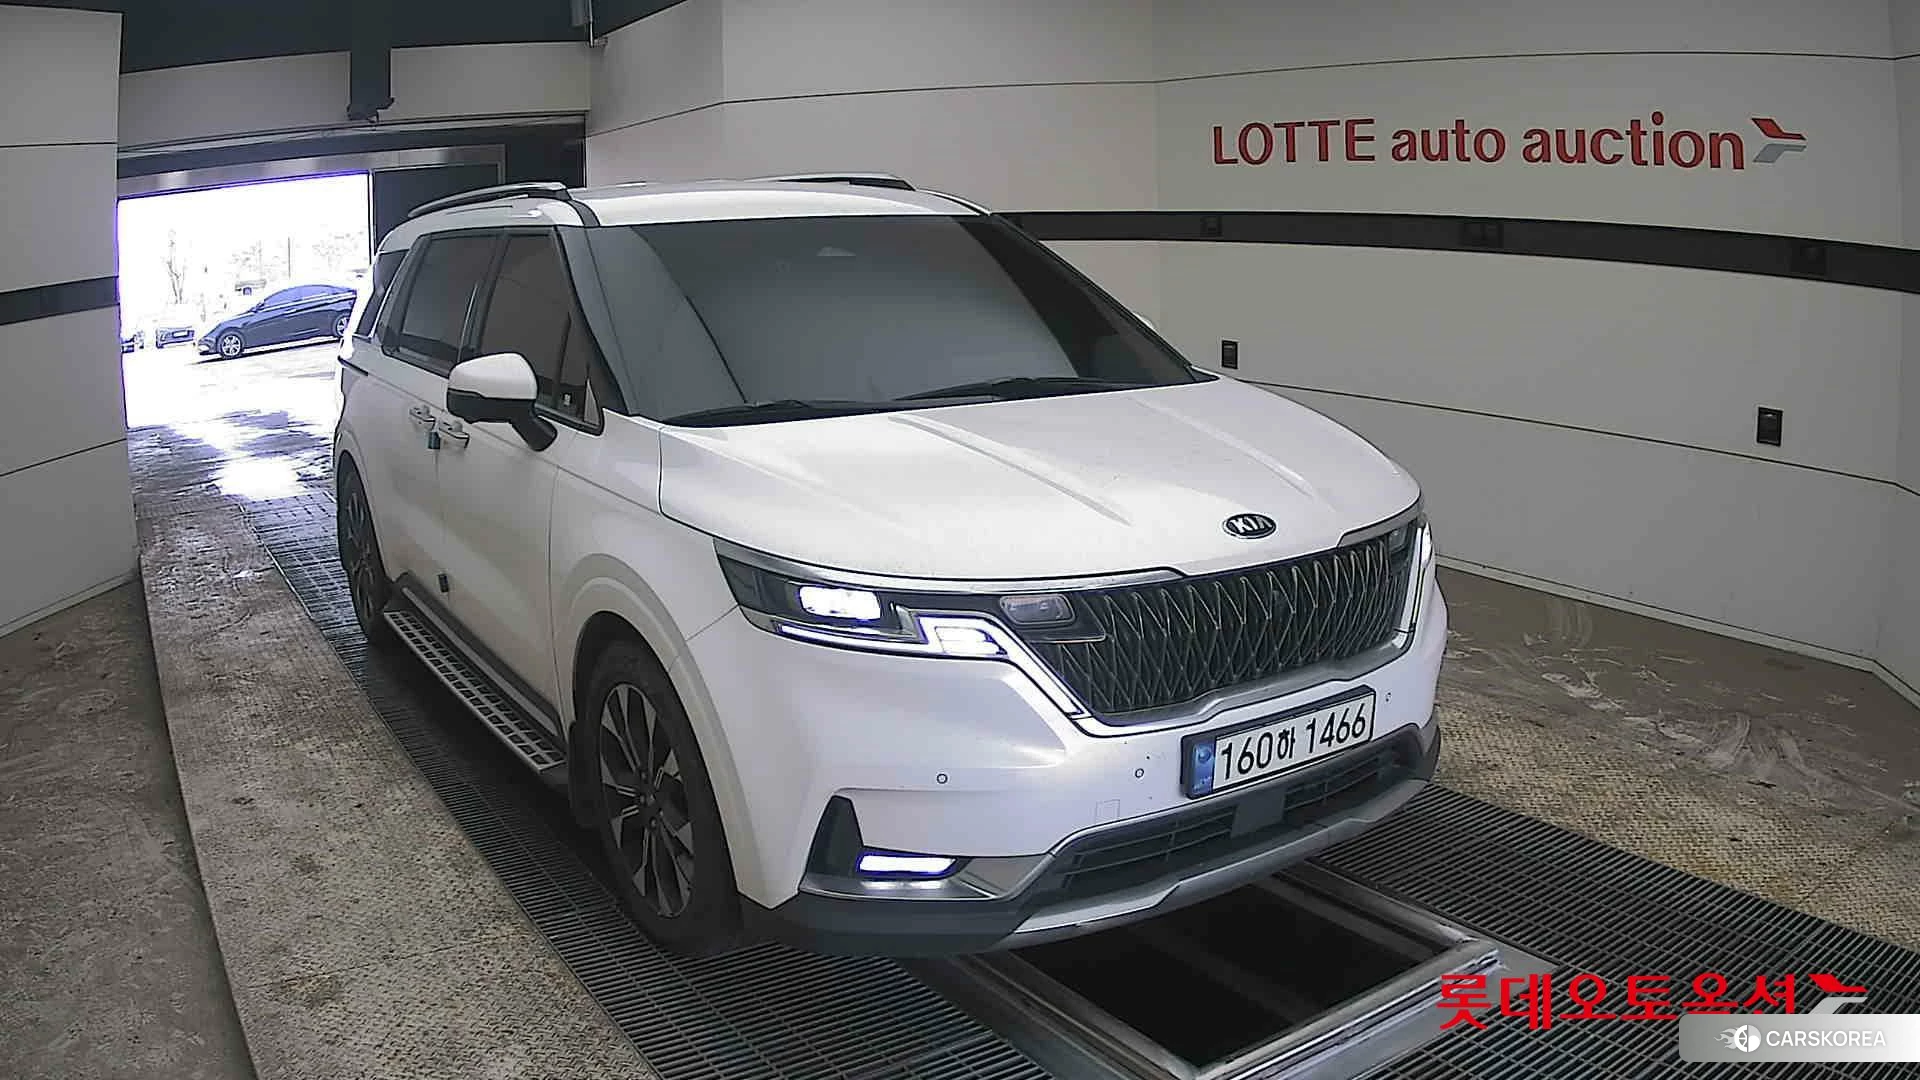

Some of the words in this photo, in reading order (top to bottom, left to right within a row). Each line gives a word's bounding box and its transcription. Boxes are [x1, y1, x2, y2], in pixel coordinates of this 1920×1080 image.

[1213, 118, 1376, 164] LOTTE
[1391, 119, 1506, 163] auto
[1522, 111, 1744, 170] auction
[1229, 515, 1272, 533] KIA
[1221, 726, 1296, 780] 160하
[1305, 703, 1367, 754] 1466
